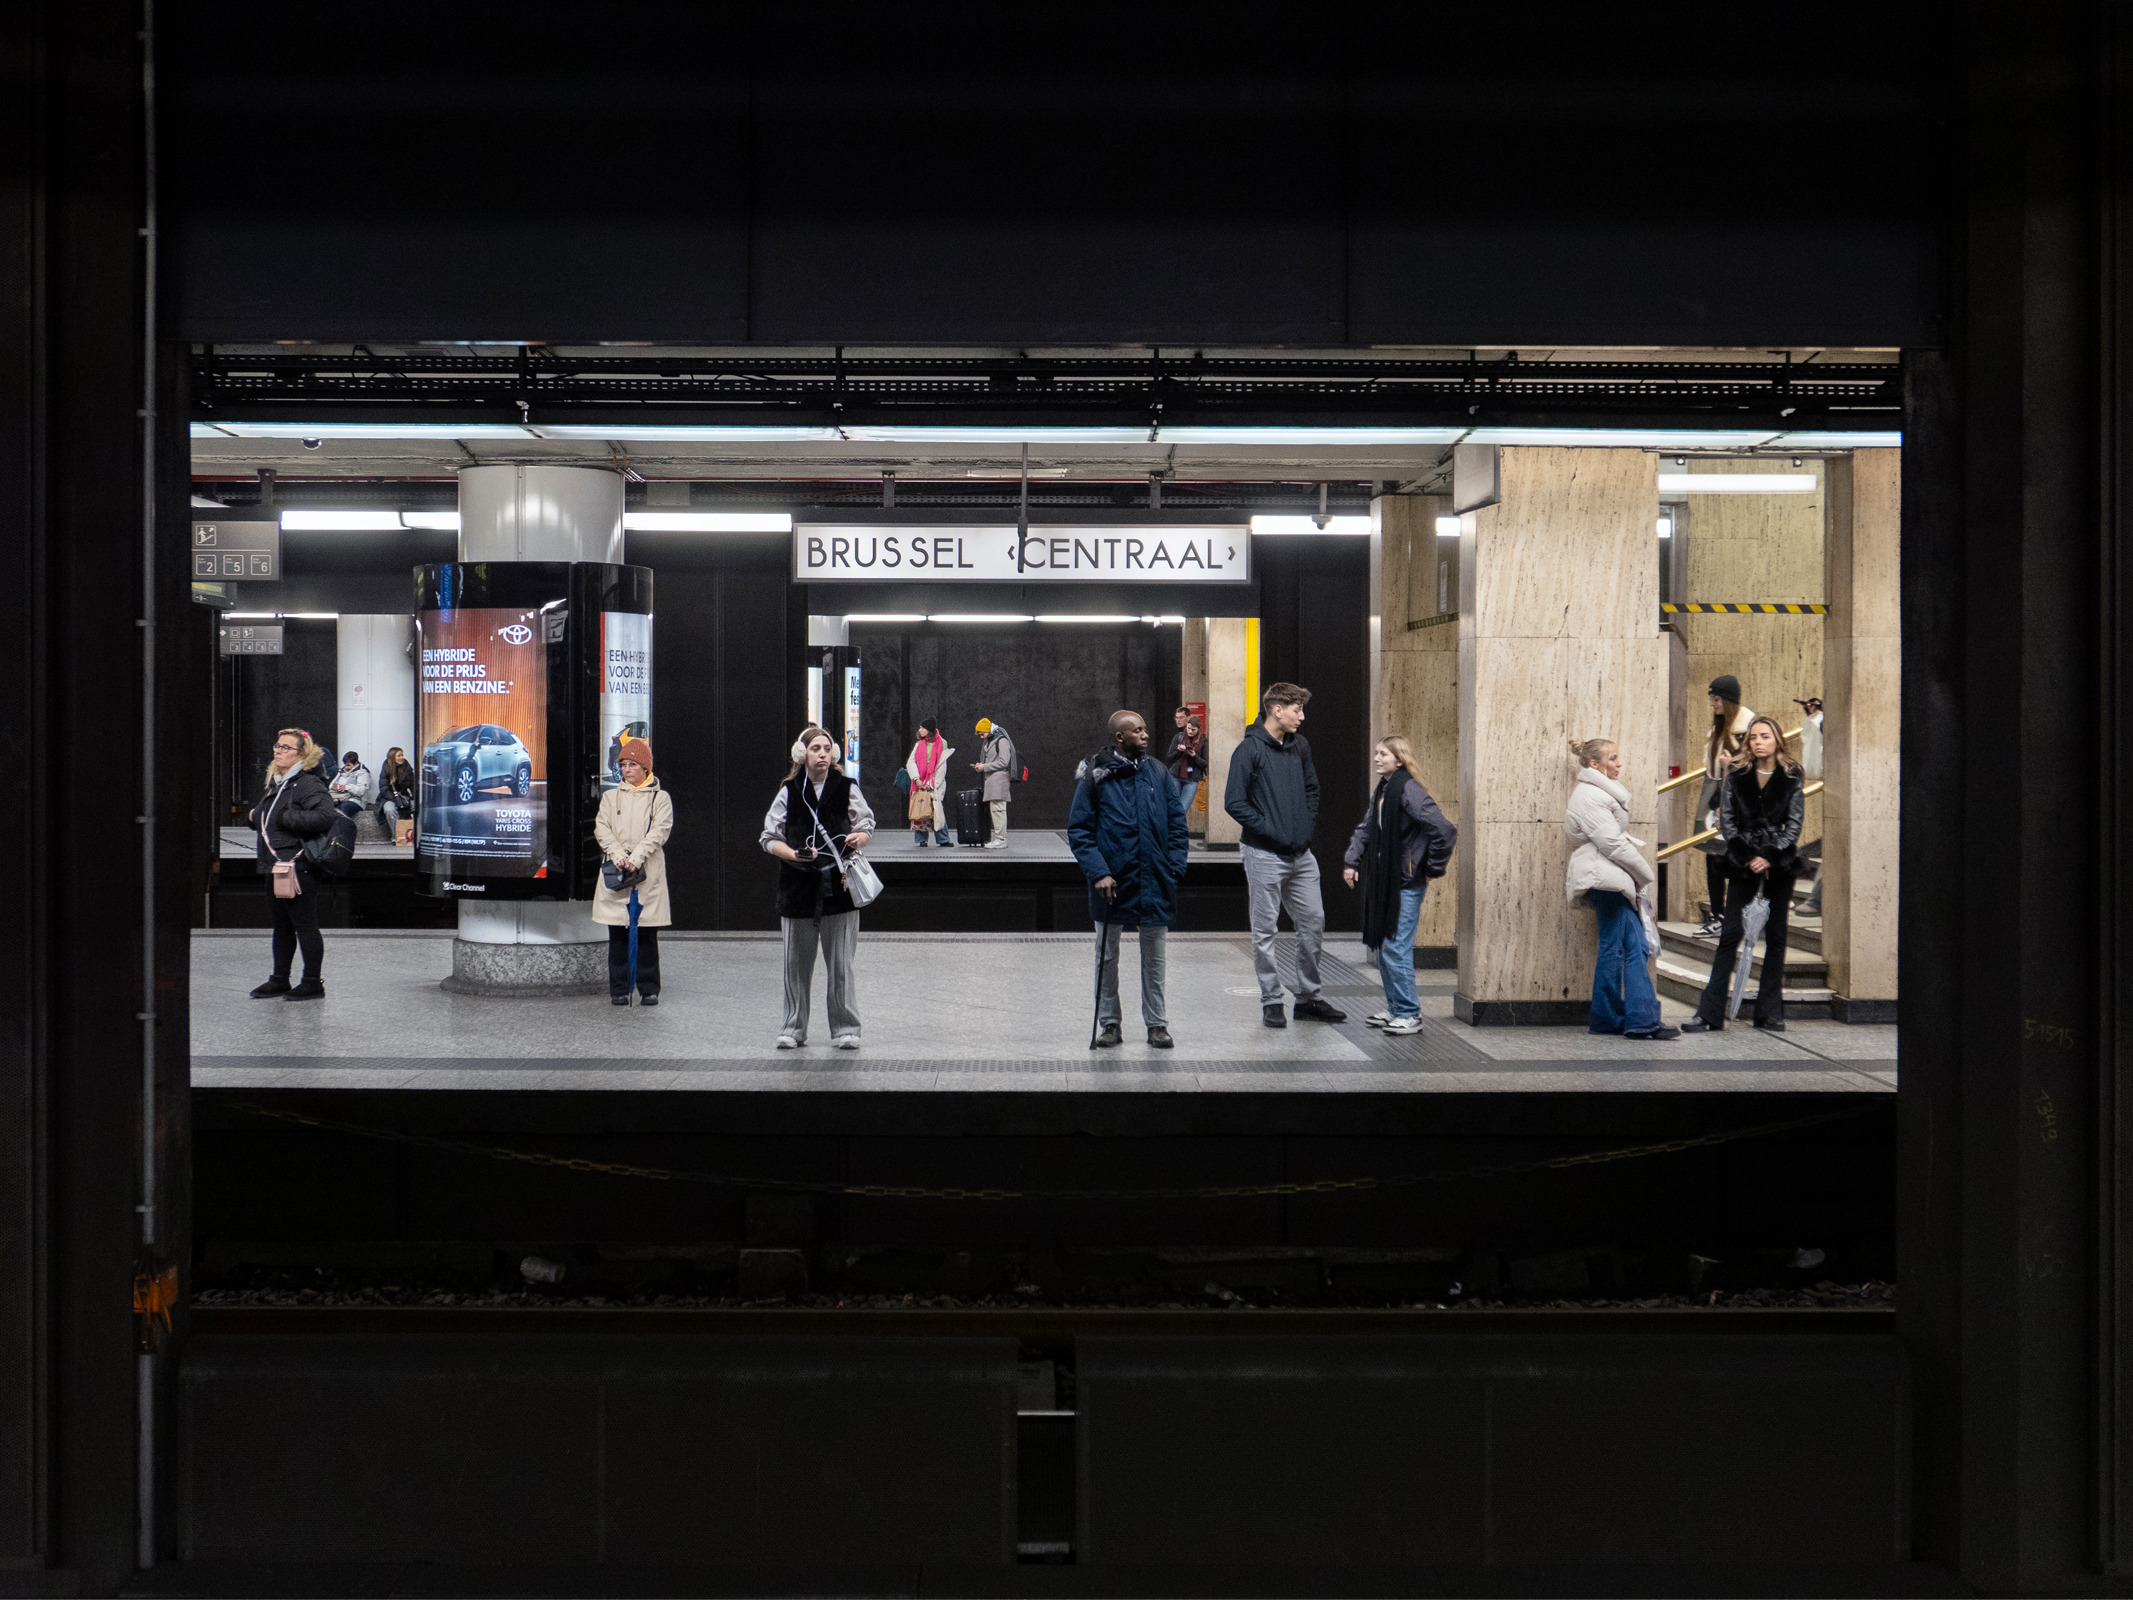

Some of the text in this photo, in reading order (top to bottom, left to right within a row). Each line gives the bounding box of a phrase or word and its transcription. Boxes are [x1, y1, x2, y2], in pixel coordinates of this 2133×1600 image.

[807, 537, 974, 568] BRUSSEL
[207, 562, 268, 572] 2 5 6
[423, 648, 476, 662] EEN HYBRIDE
[609, 650, 627, 662] EEN
[422, 664, 486, 678] VOOR DE PRIJS
[608, 665, 635, 678] VOOR
[637, 667, 643, 679] DE
[422, 681, 434, 694] VAN
[435, 681, 451, 694] EEN
[609, 681, 628, 693] VAN
[631, 682, 642, 694] EEN
[495, 809, 532, 818] TOYOTA
[495, 824, 532, 832] HYBRIDE
[449, 883, 486, 892] Clear Channel
